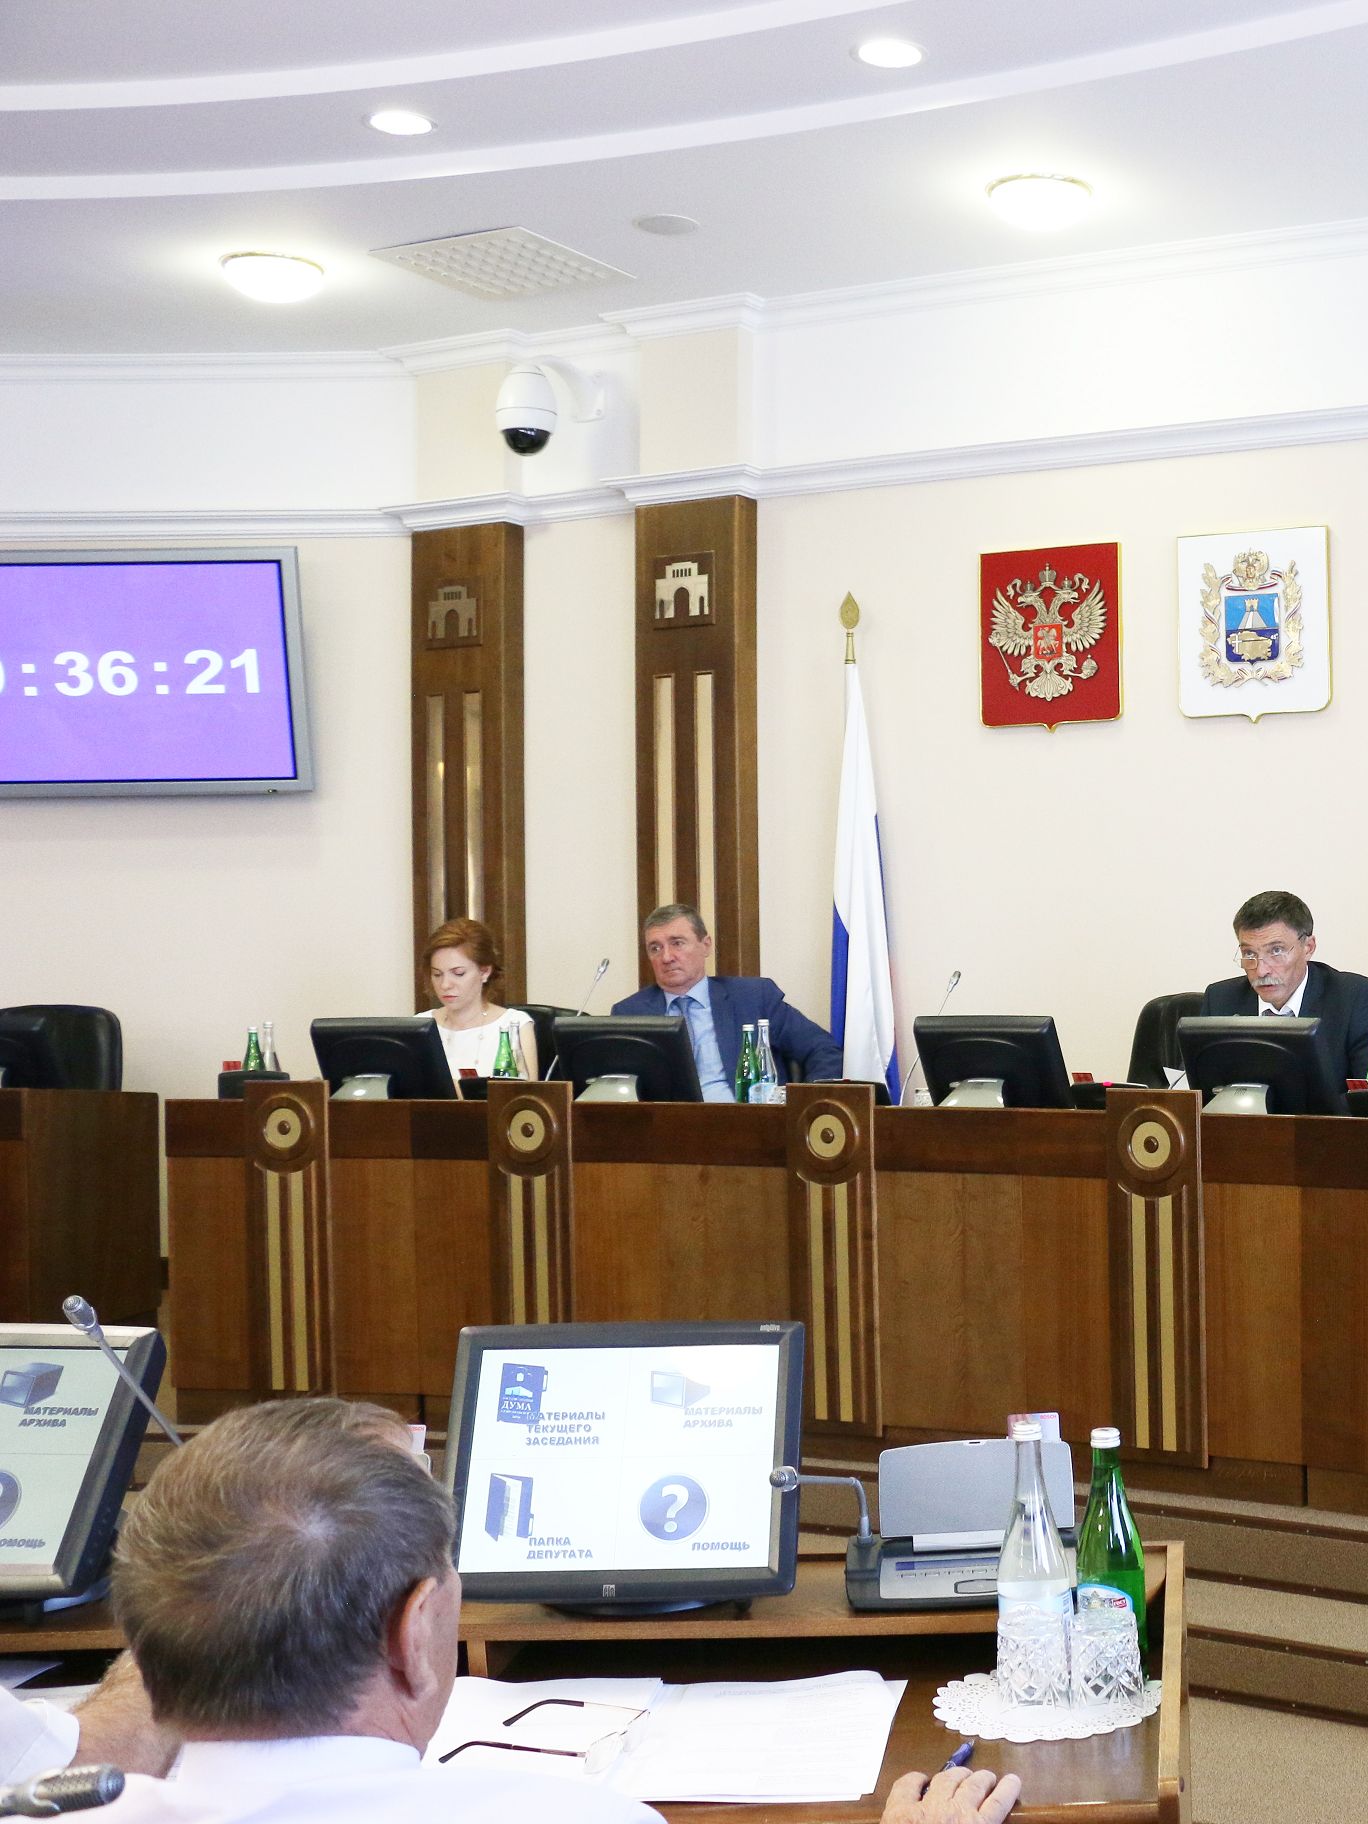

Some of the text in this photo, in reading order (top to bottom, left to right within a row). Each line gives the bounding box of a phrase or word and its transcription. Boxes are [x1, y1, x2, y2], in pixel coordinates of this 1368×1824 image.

[0, 649, 261, 697] :36:21
[501, 1400, 532, 1411] ДУМА
[684, 1406, 763, 1416] МАТЕРИАЛЫ
[23, 1406, 99, 1417] МАТЕРИАЛЫ
[527, 1411, 606, 1421] МАТЕРИАЛЫ
[18, 1418, 67, 1428] АРХИВА
[683, 1419, 734, 1429] АРХИВА
[526, 1423, 592, 1435] ТЕКУЩЕГО
[525, 1436, 600, 1446] ЗАСЕДАНИЯ
[0, 1538, 46, 1549] ОМОЩЬ
[528, 1536, 571, 1547] ПАПКА
[691, 1541, 750, 1552] ПОМОЩЬ
[526, 1549, 593, 1560] ДЕПУТАТА
